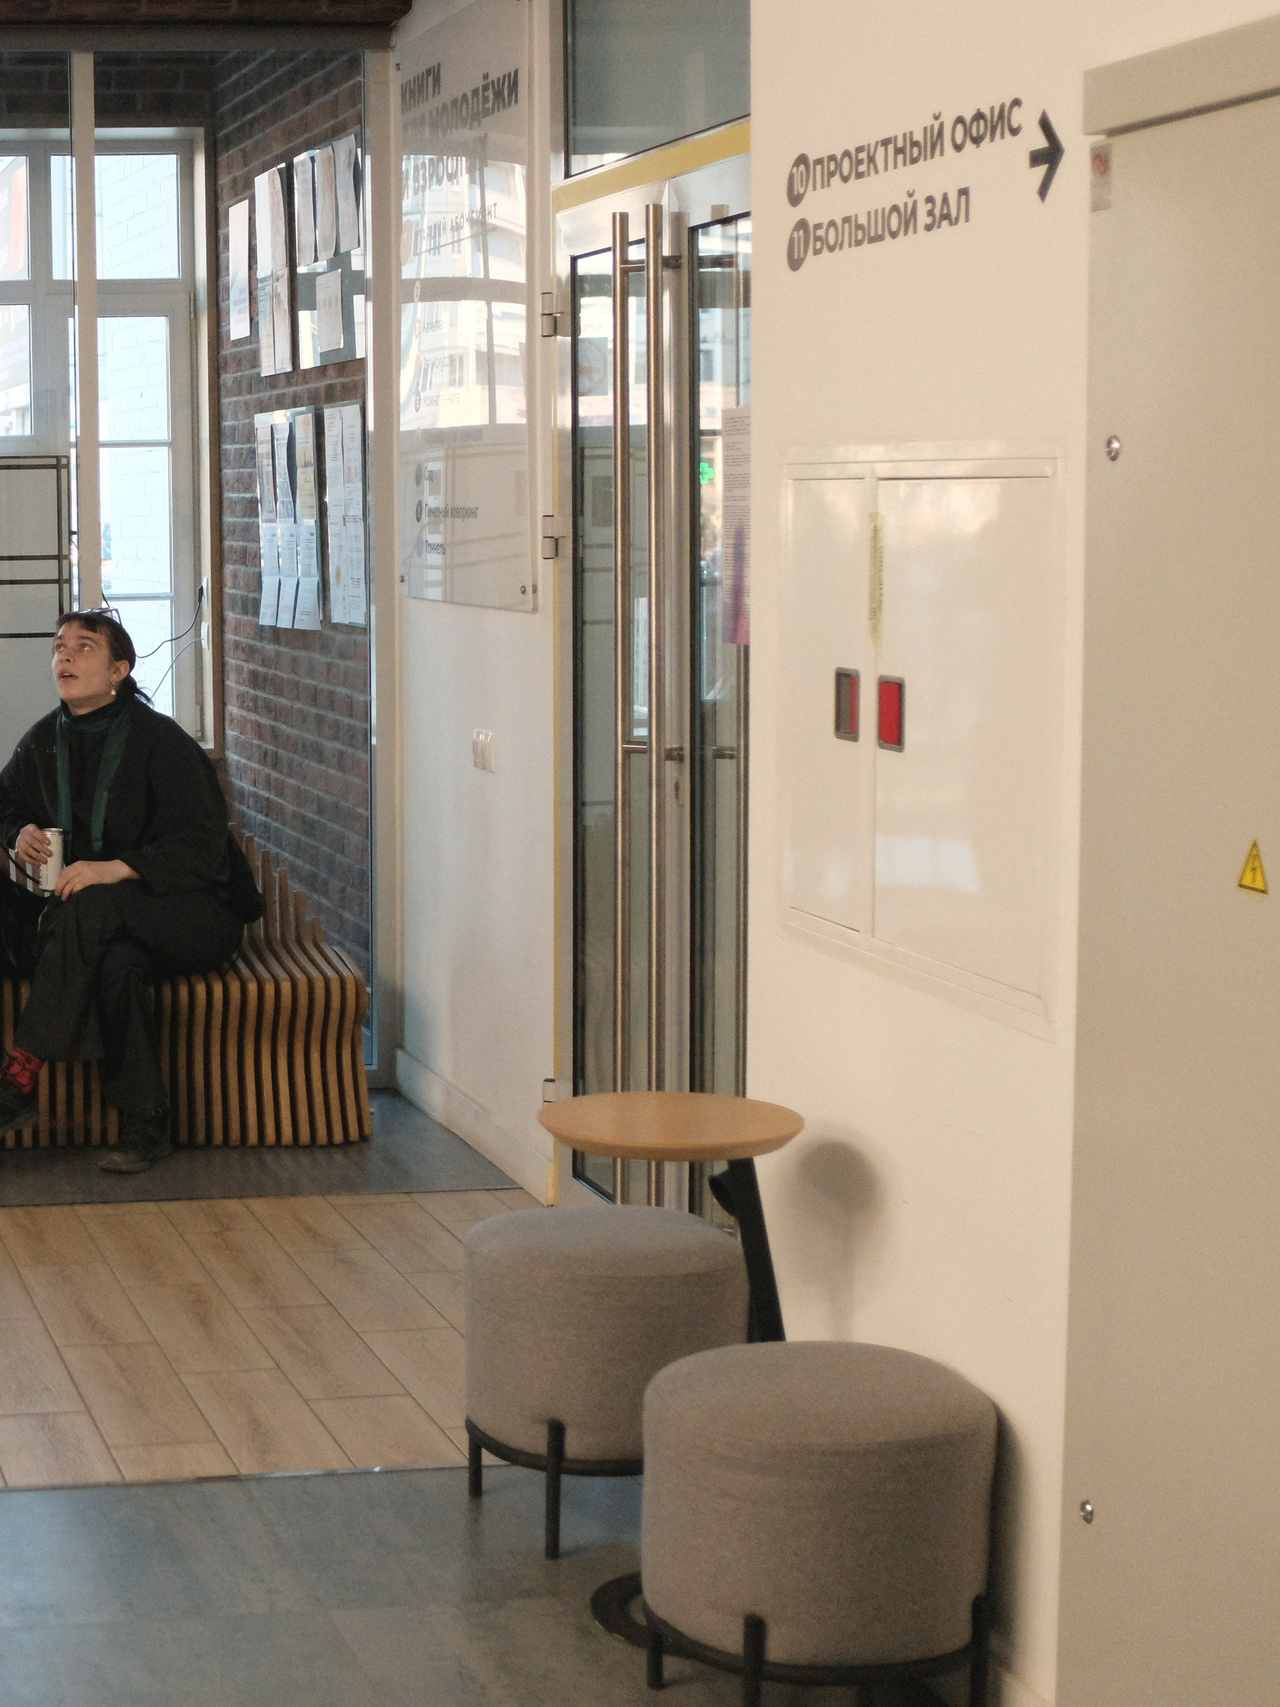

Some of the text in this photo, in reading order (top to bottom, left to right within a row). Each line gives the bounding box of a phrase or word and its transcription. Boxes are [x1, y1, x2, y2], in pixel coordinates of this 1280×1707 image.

[401, 62, 441, 114] КНИГИ
[429, 68, 519, 139] МОЛОДЁЖИ
[812, 111, 945, 191] ПРОЕКТНЫЙ
[950, 97, 1023, 153] ОФИС
[812, 189, 918, 257] БОЛЬШОЙ
[923, 186, 970, 232] ЗАЛ
